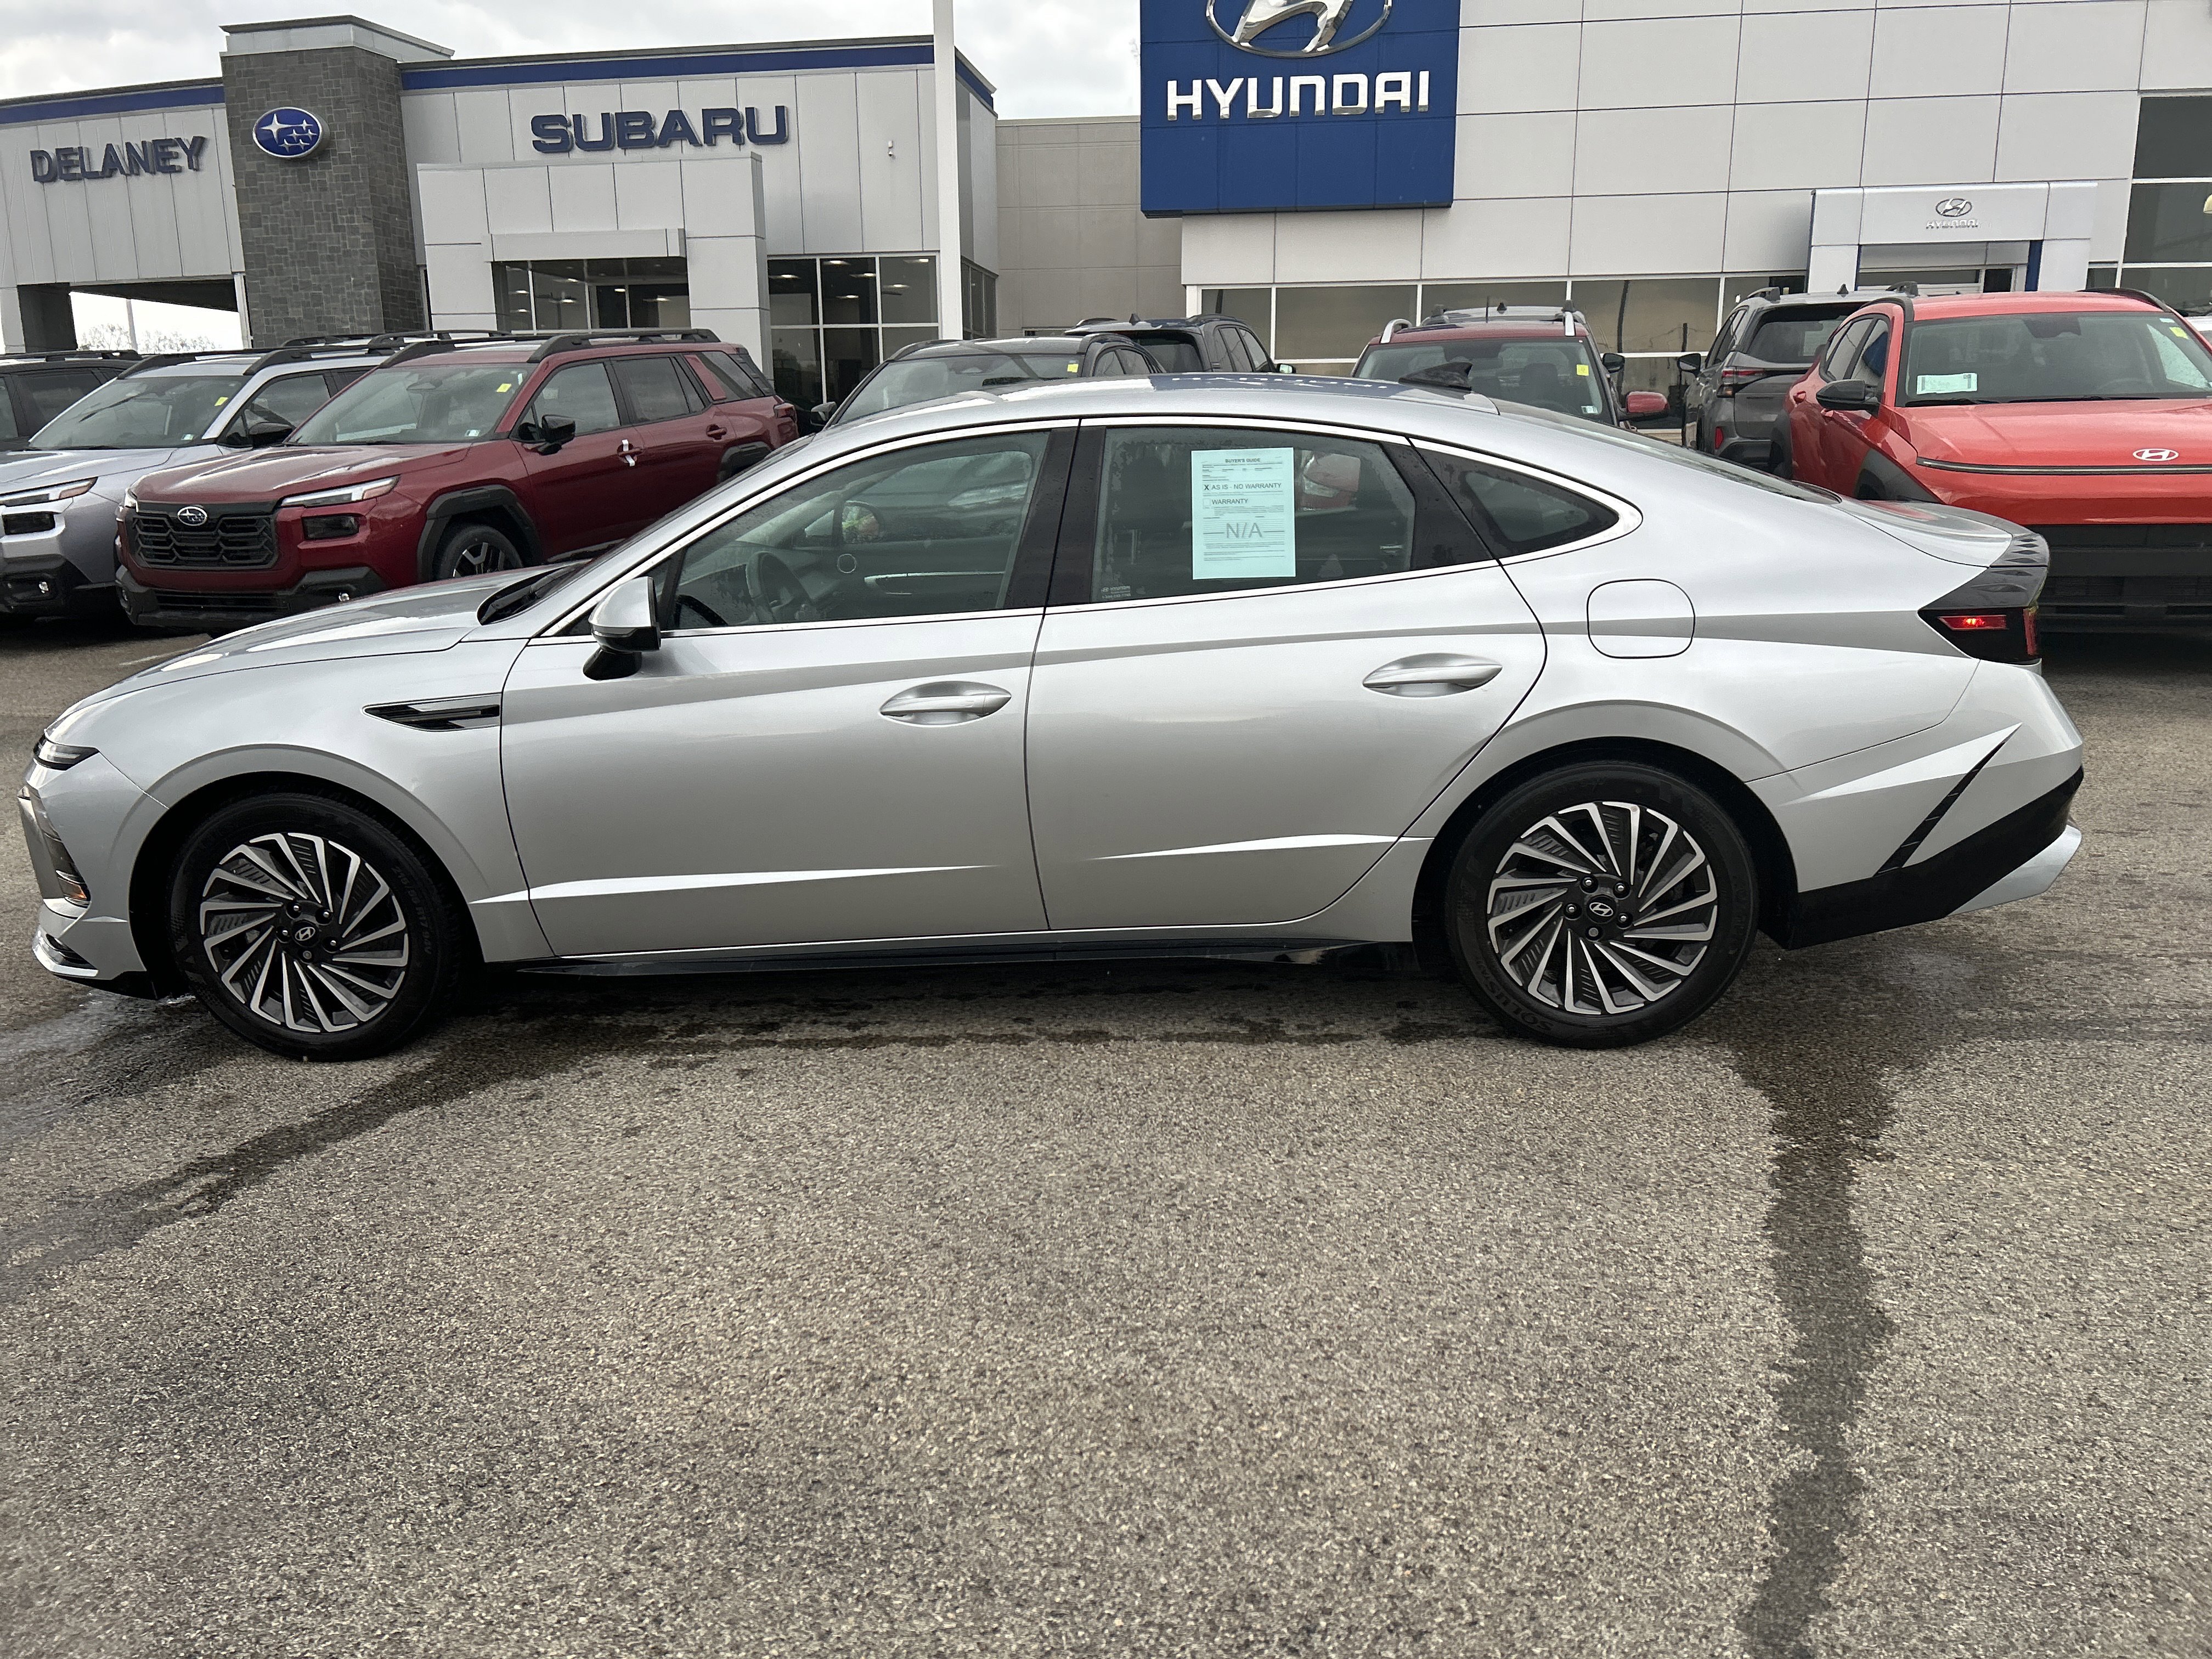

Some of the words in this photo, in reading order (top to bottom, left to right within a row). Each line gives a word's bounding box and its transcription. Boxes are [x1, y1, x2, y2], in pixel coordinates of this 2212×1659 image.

[1167, 70, 1429, 121] HYUNDAI
[531, 105, 788, 152] SUBARU
[30, 136, 206, 182] DELANEY
[1926, 219, 1978, 229] HYUNDAI
[1226, 522, 1262, 538] N/A
